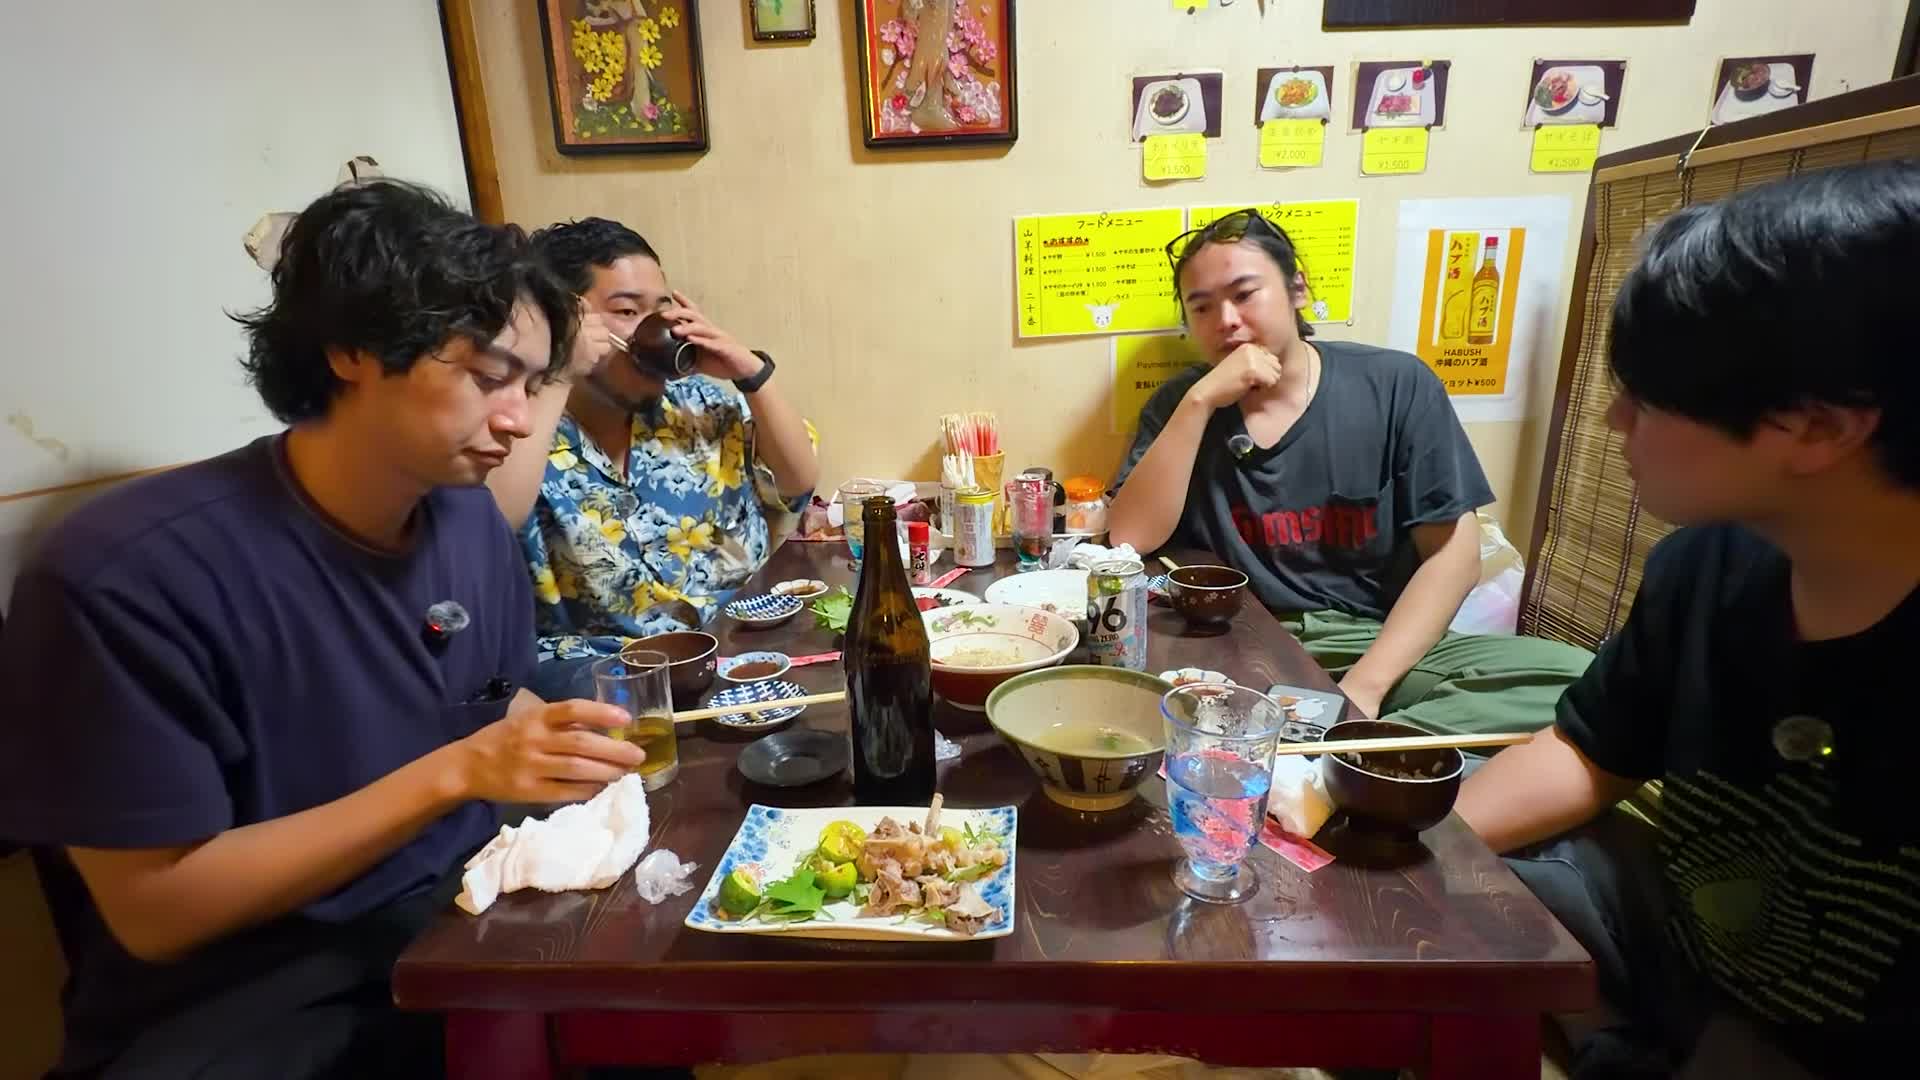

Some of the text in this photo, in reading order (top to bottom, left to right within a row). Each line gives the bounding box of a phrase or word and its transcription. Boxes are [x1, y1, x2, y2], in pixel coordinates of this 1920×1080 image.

[1077, 218, 1143, 229] フードメニュー
[1448, 239, 1463, 280] ハブ酒
[1443, 348, 1482, 357] HABUSH
